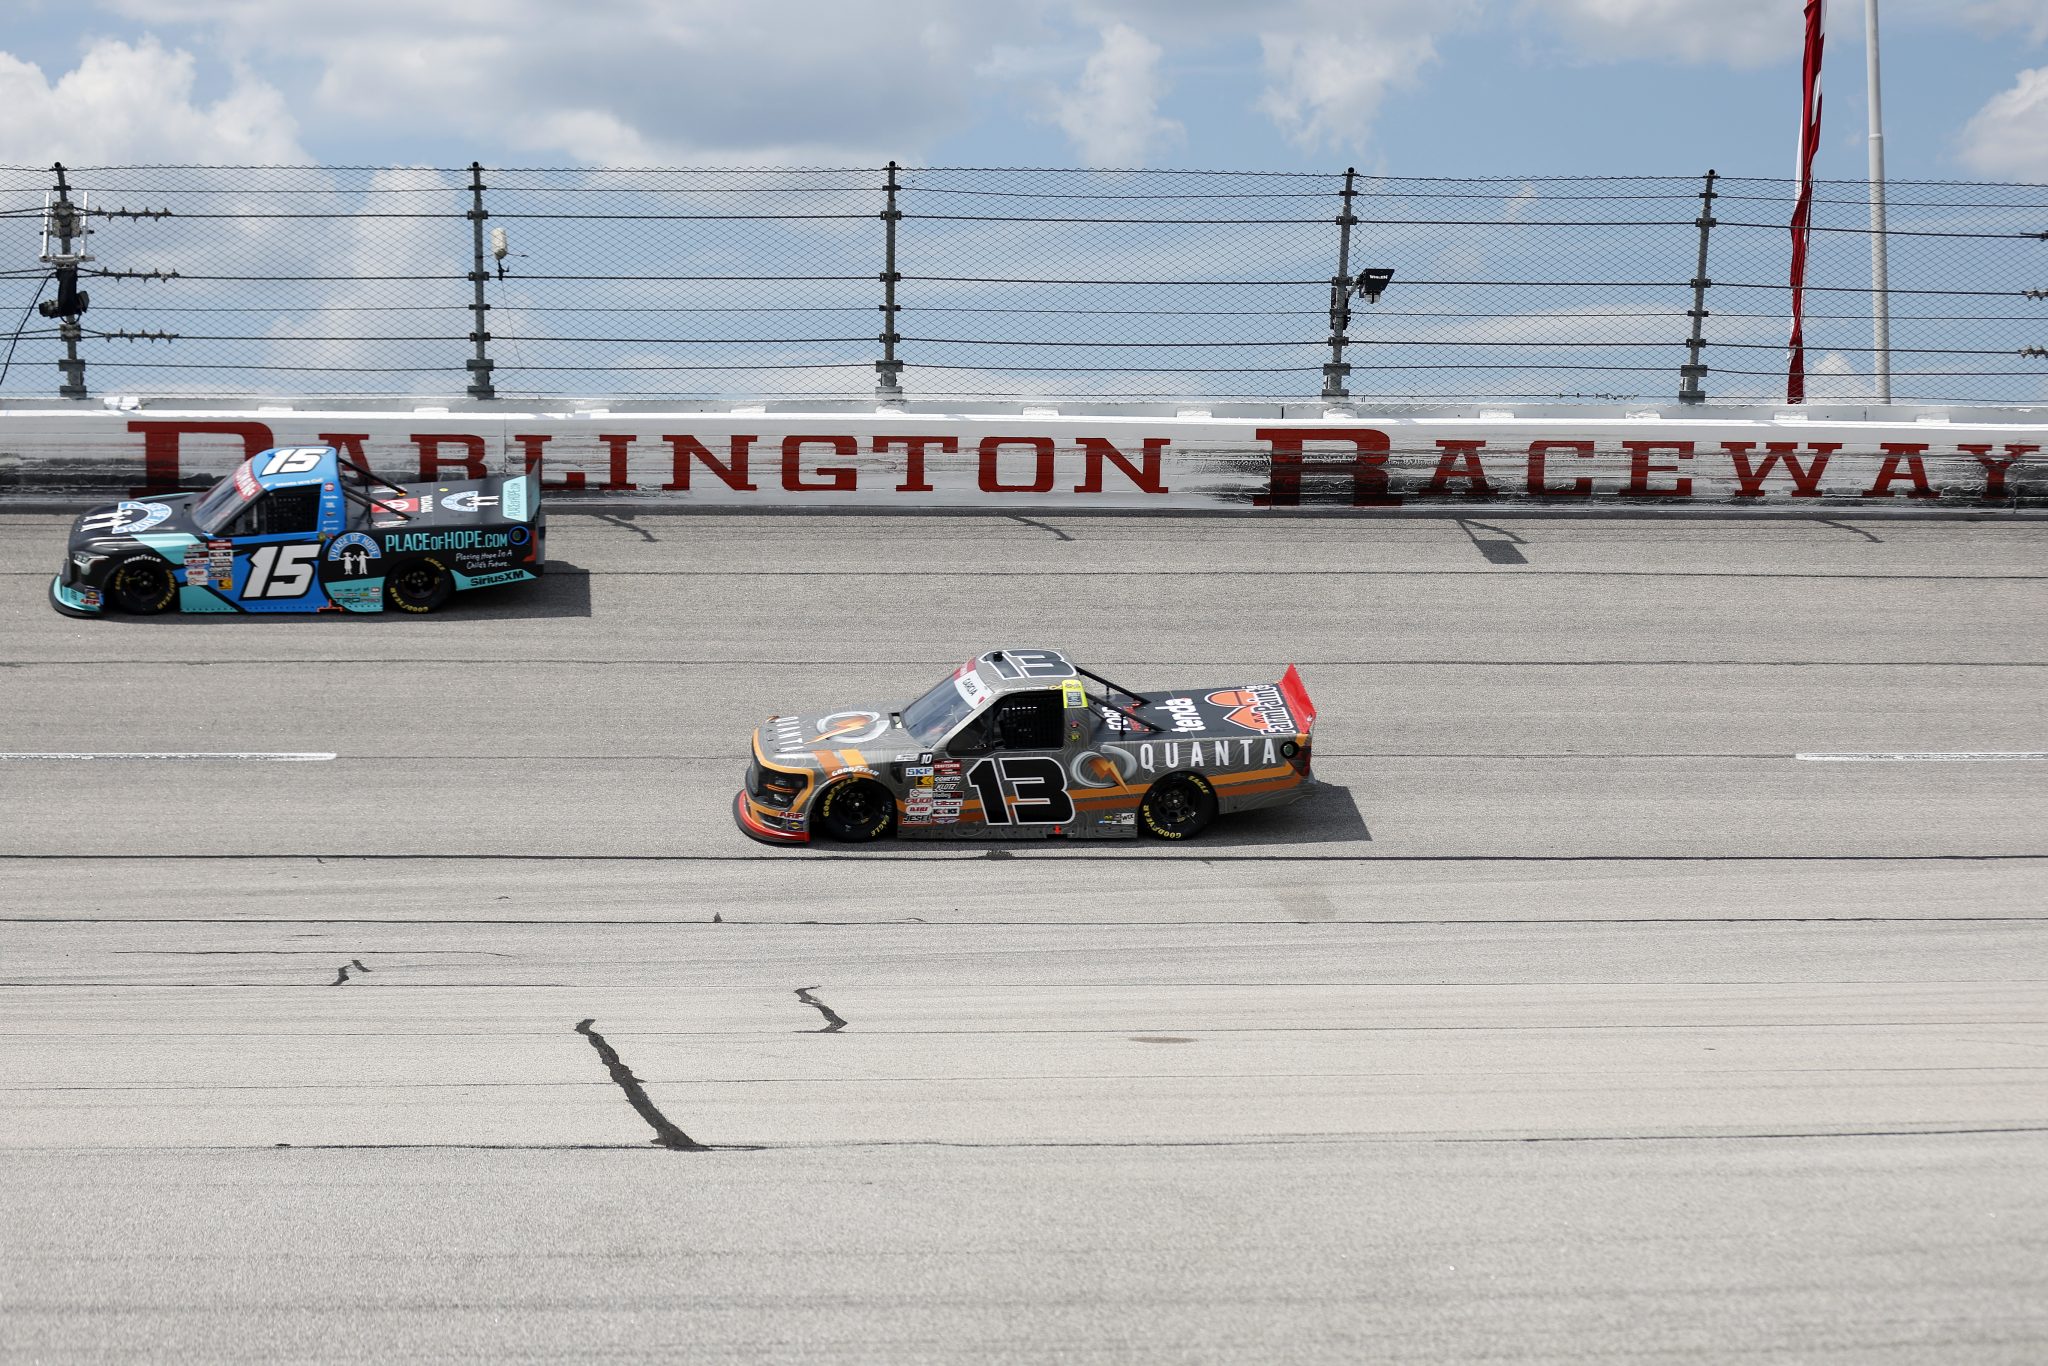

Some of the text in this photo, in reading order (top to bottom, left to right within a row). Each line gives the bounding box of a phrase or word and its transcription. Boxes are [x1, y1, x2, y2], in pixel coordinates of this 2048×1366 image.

[128, 421, 1171, 499] DARLINGTON
[1253, 428, 2042, 506] RACEWAY
[259, 447, 331, 477] 15
[328, 534, 380, 559] PLACE OF HOPE
[239, 544, 321, 600] 15
[470, 570, 525, 587] SiriusXM
[978, 648, 1078, 681] 13
[1154, 697, 1207, 733] tenda
[831, 765, 880, 778] GOODYEAR
[907, 768, 933, 776] SKF
[920, 753, 933, 765] 10
[1140, 738, 1277, 773] QUANTA
[966, 756, 1076, 825] 13
[1142, 804, 1182, 839] GOODYEAR
